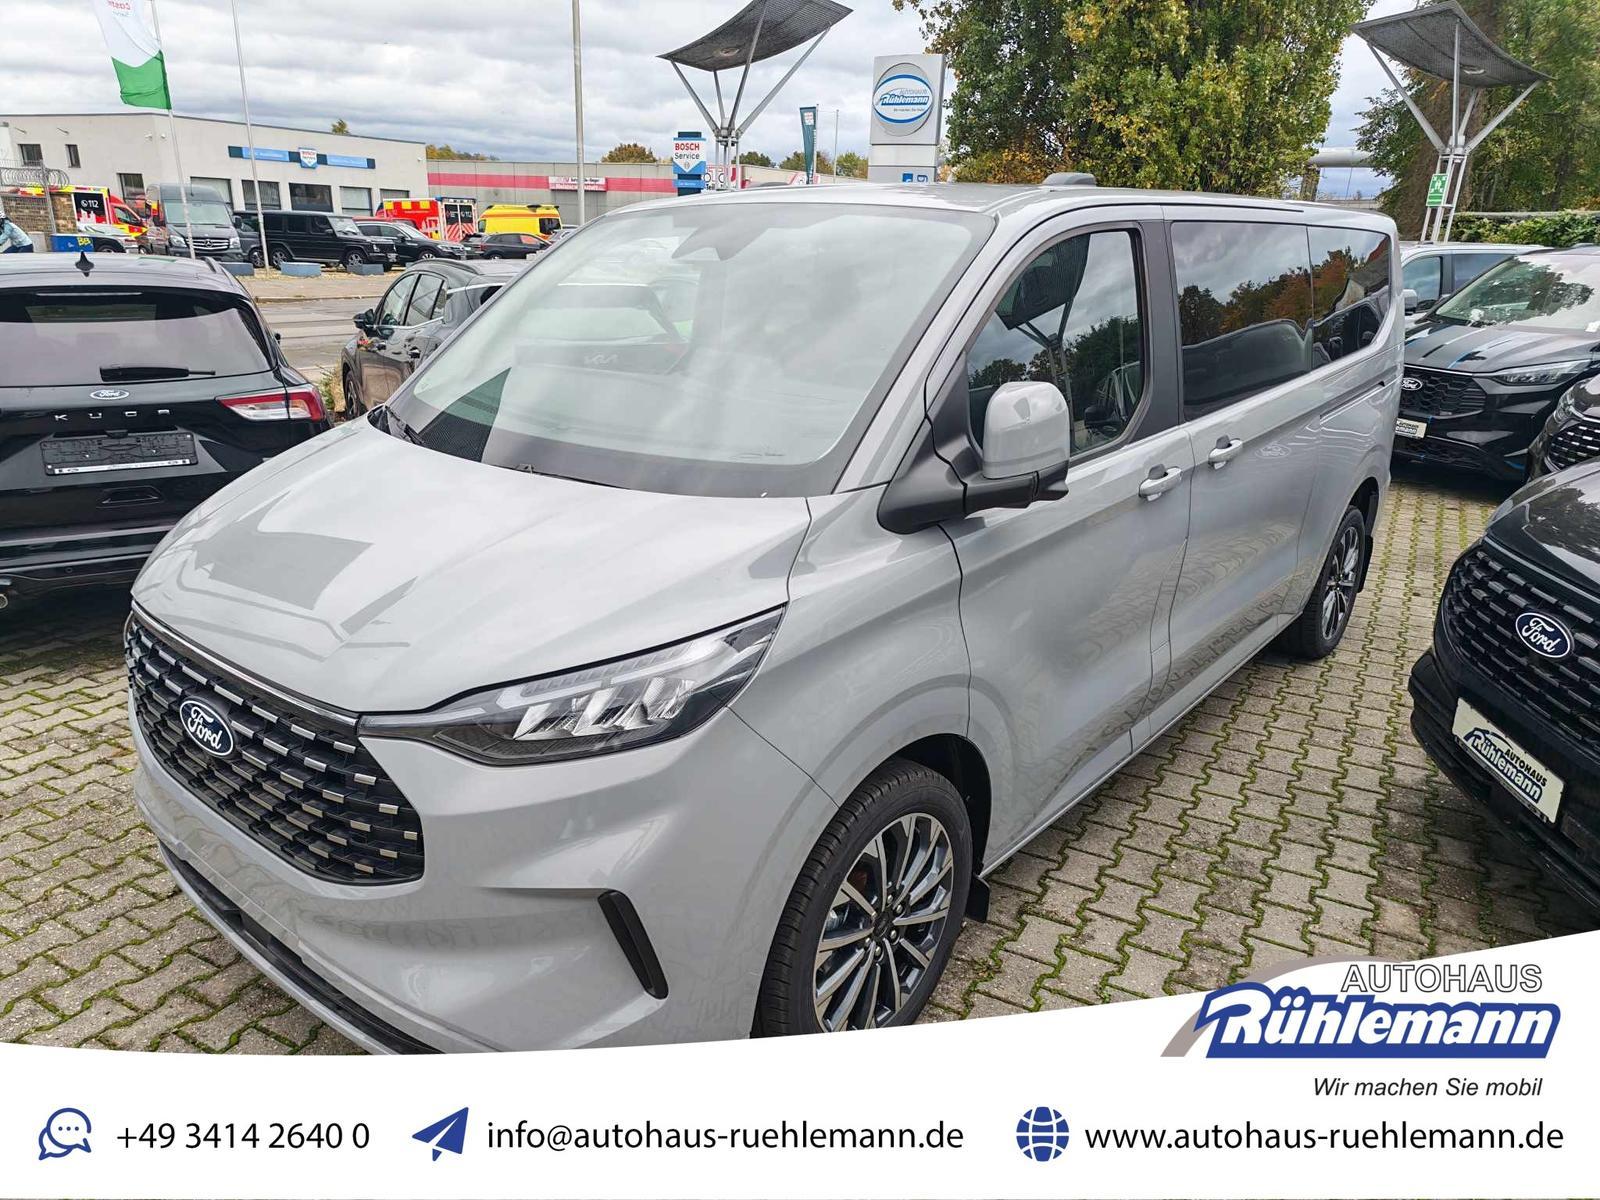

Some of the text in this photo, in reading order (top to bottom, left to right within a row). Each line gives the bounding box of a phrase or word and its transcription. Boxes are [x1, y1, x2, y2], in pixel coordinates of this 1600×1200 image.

[674, 152, 700, 160] Service
[675, 143, 700, 151] BOSCH
[88, 200, 99, 208] 112
[1521, 617, 1562, 653] Ford
[187, 706, 223, 750] Ford
[1465, 730, 1542, 802] Rühlemann
[1504, 749, 1548, 788] AUTOHAUS
